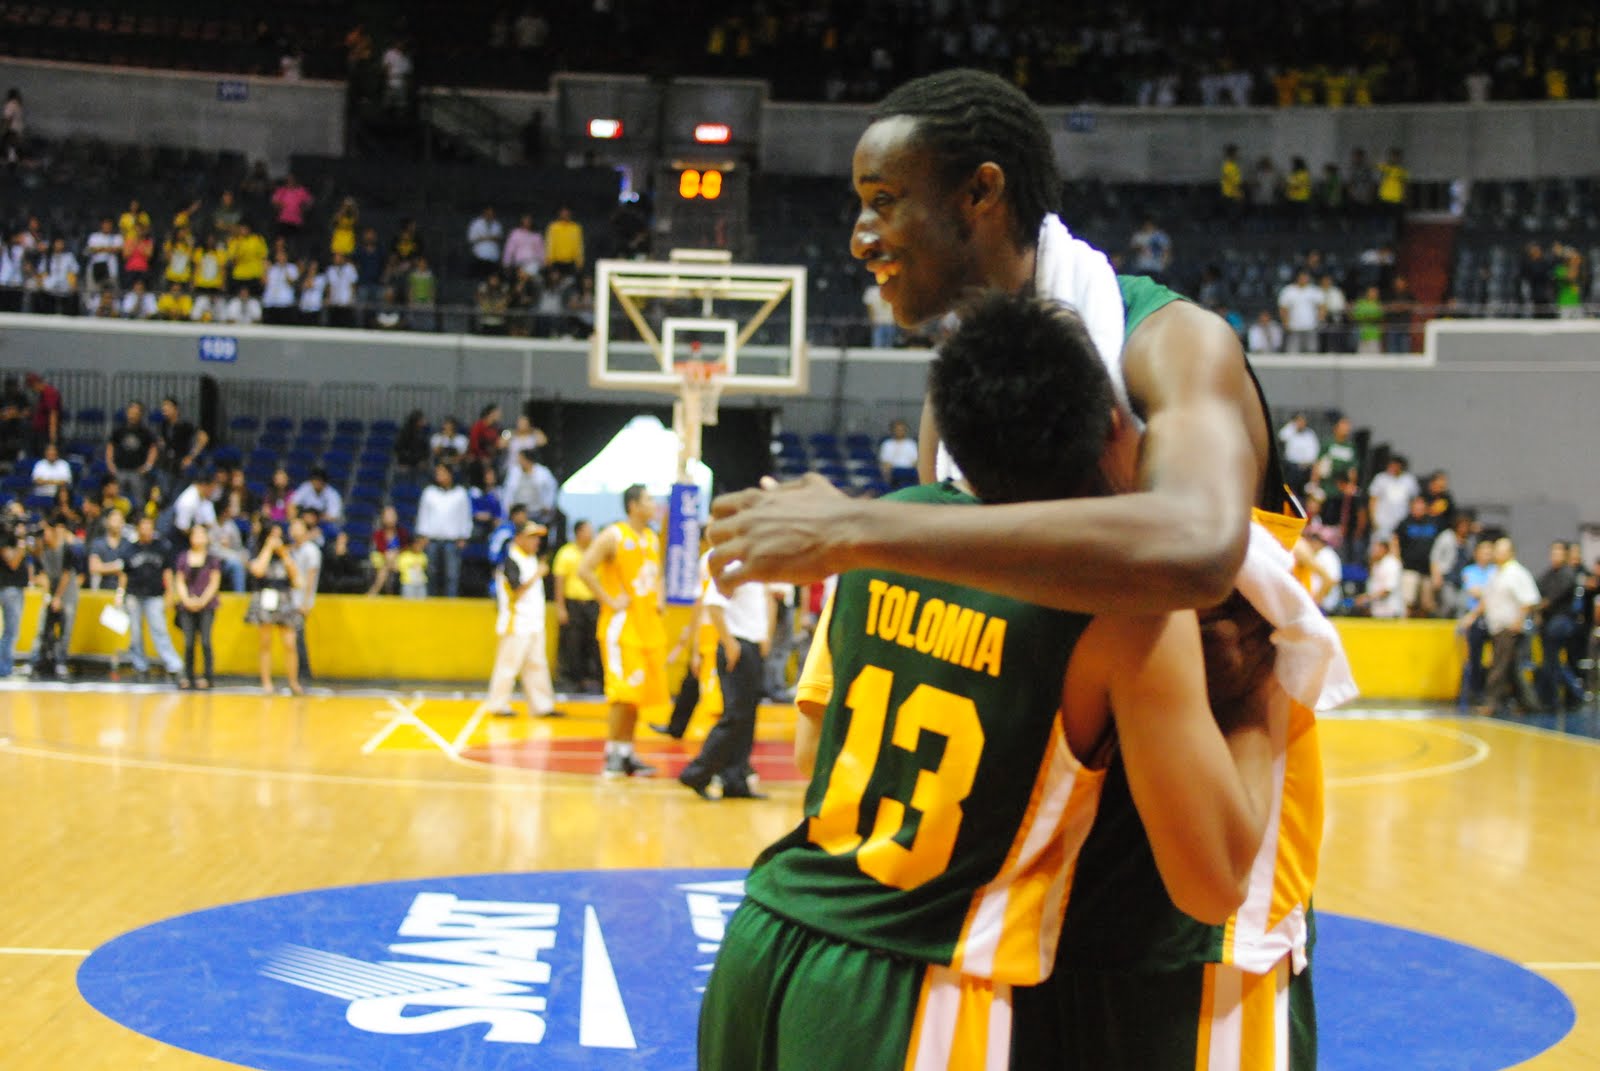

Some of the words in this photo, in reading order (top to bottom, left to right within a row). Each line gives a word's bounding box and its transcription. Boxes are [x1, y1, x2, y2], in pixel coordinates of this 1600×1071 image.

[866, 579, 1007, 677] TOLOMIA
[808, 664, 985, 891] 13
[346, 892, 560, 1044] SMART
